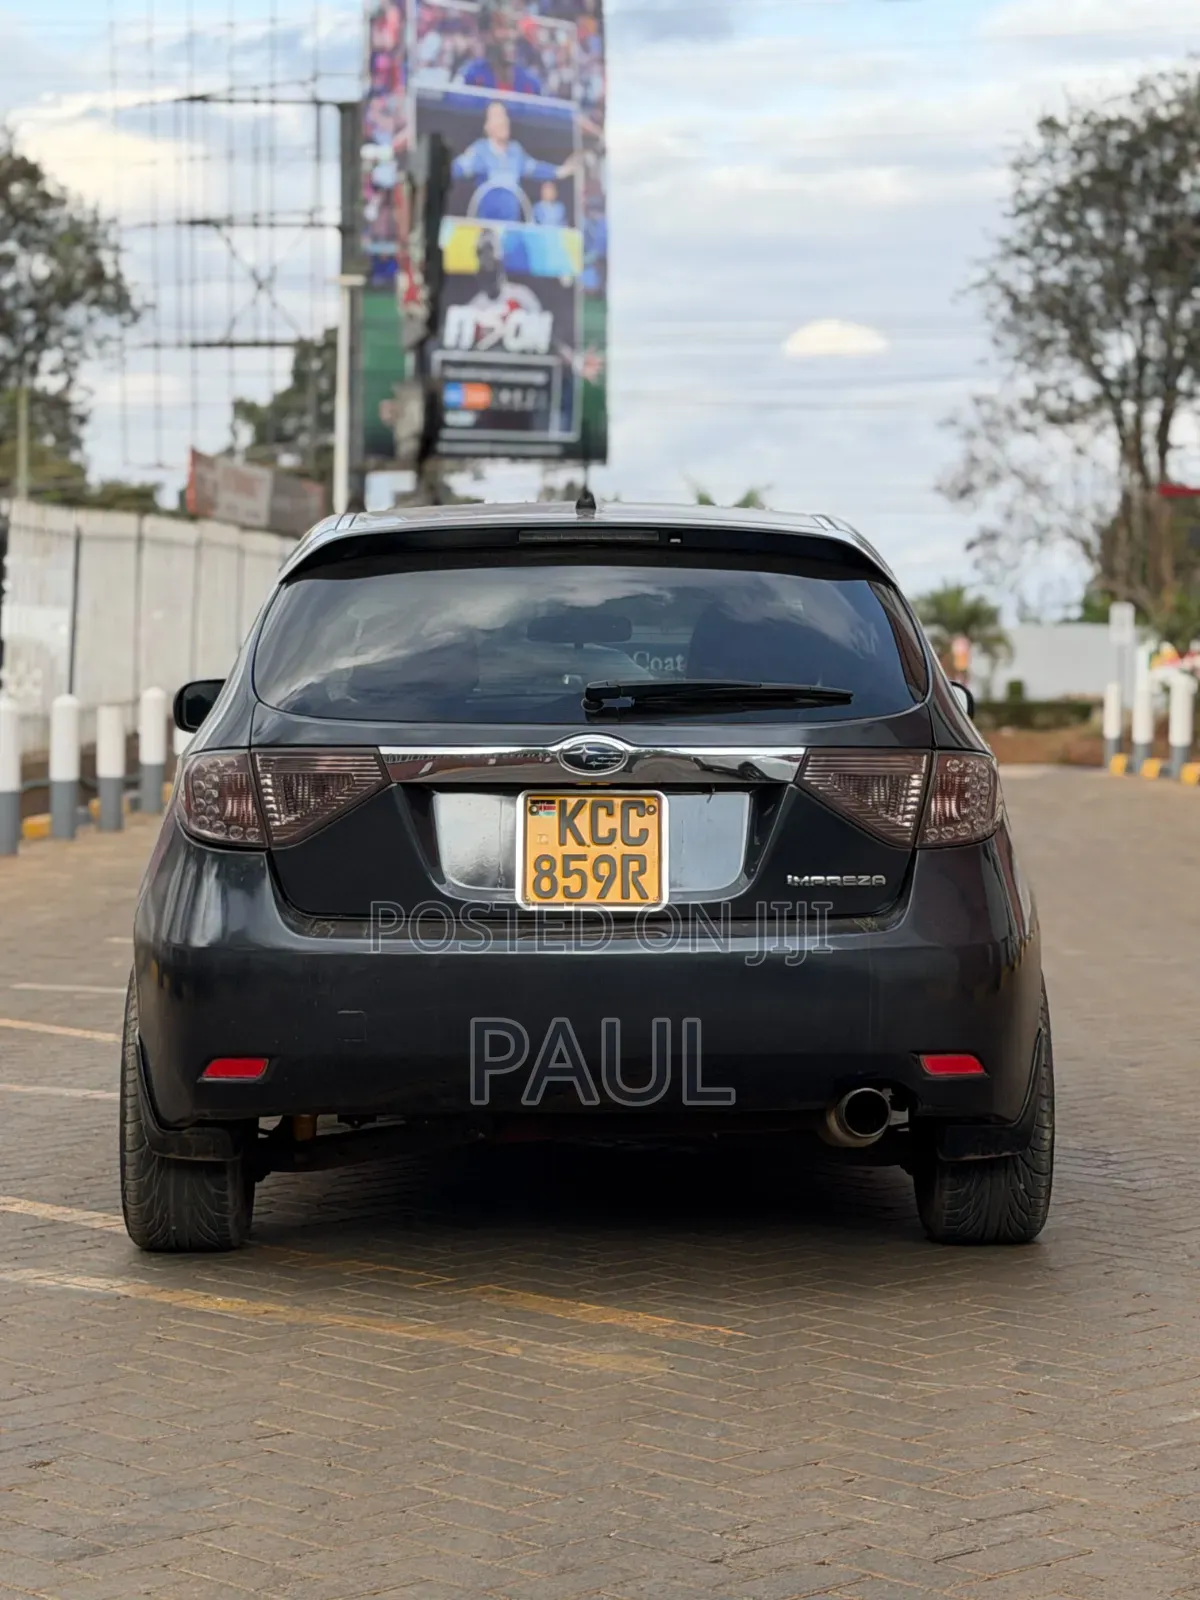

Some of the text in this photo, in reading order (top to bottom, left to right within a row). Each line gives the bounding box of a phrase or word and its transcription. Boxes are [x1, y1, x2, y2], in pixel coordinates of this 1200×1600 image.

[558, 799, 649, 847] KCC
[532, 853, 649, 900] 859R
[786, 874, 886, 886] IMPREZA
